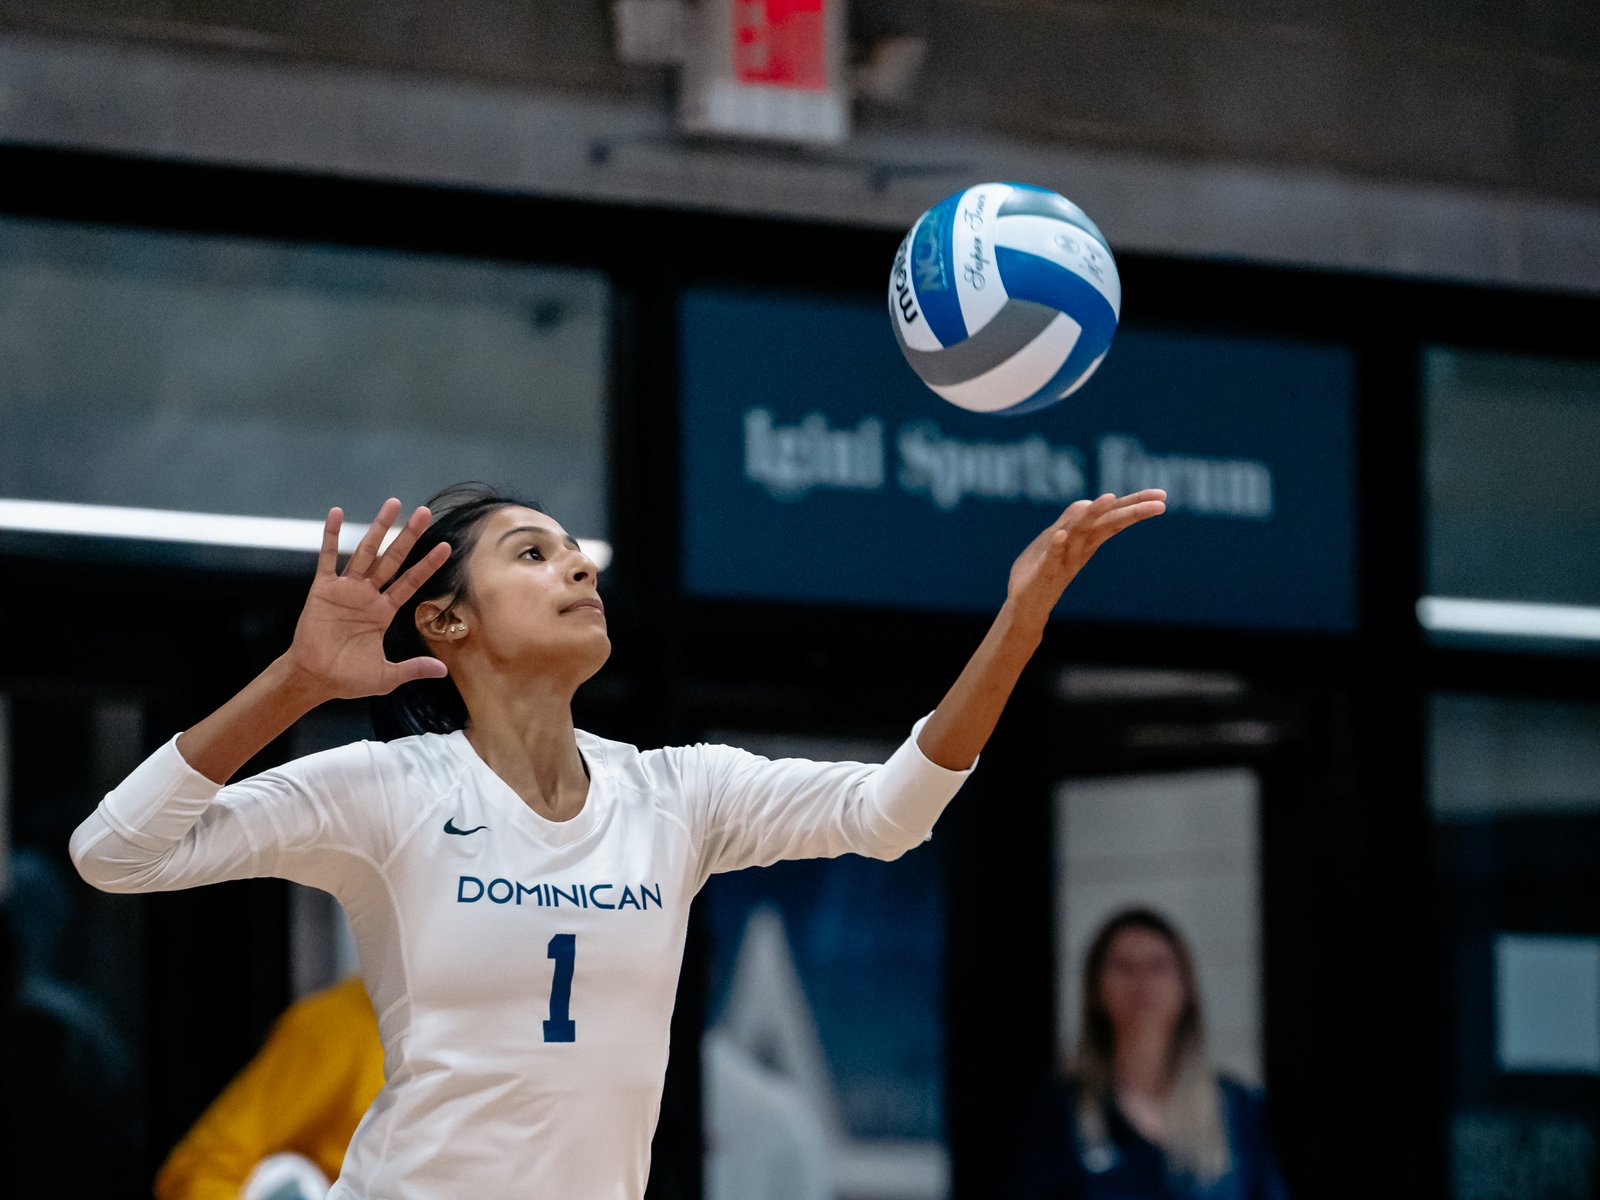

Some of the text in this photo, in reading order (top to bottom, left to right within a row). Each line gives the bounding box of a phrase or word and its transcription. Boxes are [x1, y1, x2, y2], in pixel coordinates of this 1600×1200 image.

[963, 237, 990, 292] Super
[900, 422, 1085, 508] Sports
[1100, 435, 1273, 519] Forum
[457, 875, 663, 911] DOMINICAN
[542, 933, 576, 1043] 1
